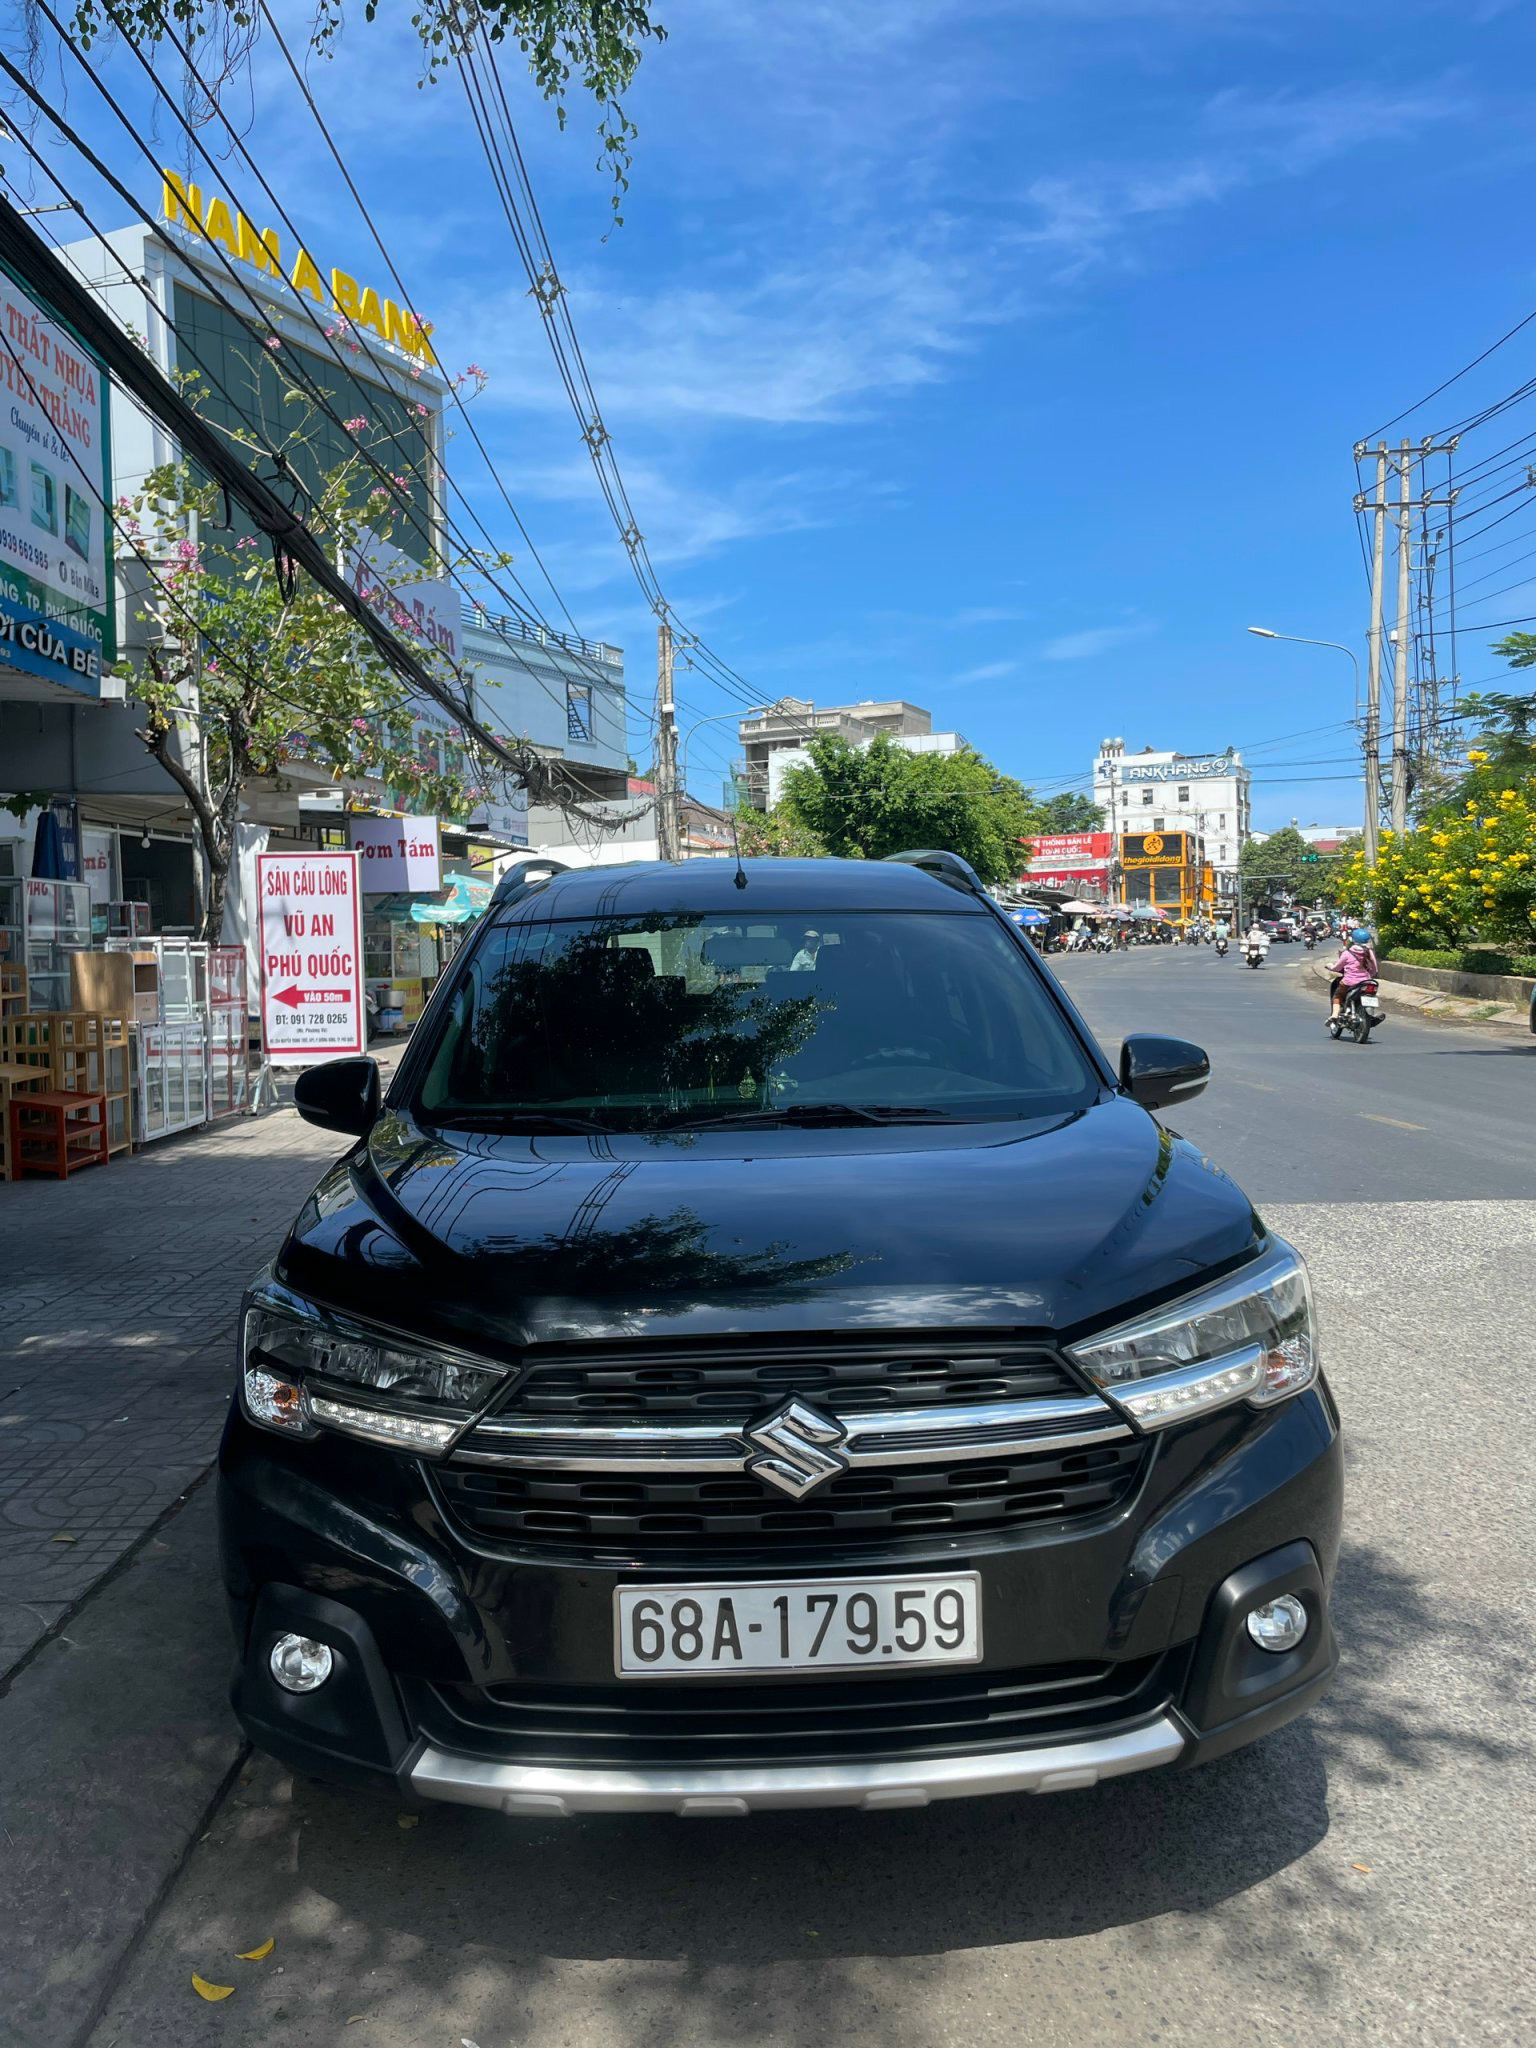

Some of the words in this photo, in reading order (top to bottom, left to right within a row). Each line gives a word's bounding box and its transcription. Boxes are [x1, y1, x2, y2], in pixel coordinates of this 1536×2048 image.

[163, 168, 281, 278] NAM
[292, 248, 324, 302] A
[331, 267, 437, 366] BANK
[7, 303, 51, 367] THẤT
[54, 343, 96, 406] NHỰA
[11, 406, 41, 443] Chuyên
[40, 384, 91, 449] THẮNG
[45, 601, 68, 627] PHÚ
[69, 614, 103, 643] QUỐC
[413, 597, 455, 656] Tấm
[21, 622, 69, 666] CỦA
[73, 647, 98, 679] BÉ
[355, 840, 393, 859] Cơm
[397, 837, 435, 858] Tấm
[1124, 855, 1181, 865] thegioididong
[267, 865, 290, 896] SÂN
[319, 865, 347, 896] LÔNG
[283, 910, 305, 937] VŨ
[311, 914, 334, 936] AN
[268, 949, 302, 977] PHÚ
[307, 945, 352, 979] QUỐC
[303, 991, 321, 1002] VÀO
[323, 992, 343, 1002] 50m
[275, 1014, 289, 1025] ĐT:
[291, 1014, 306, 1025] 091
[309, 1014, 325, 1025] 728
[327, 1013, 348, 1024] 0265
[631, 1588, 966, 1663] 68A-179.59
